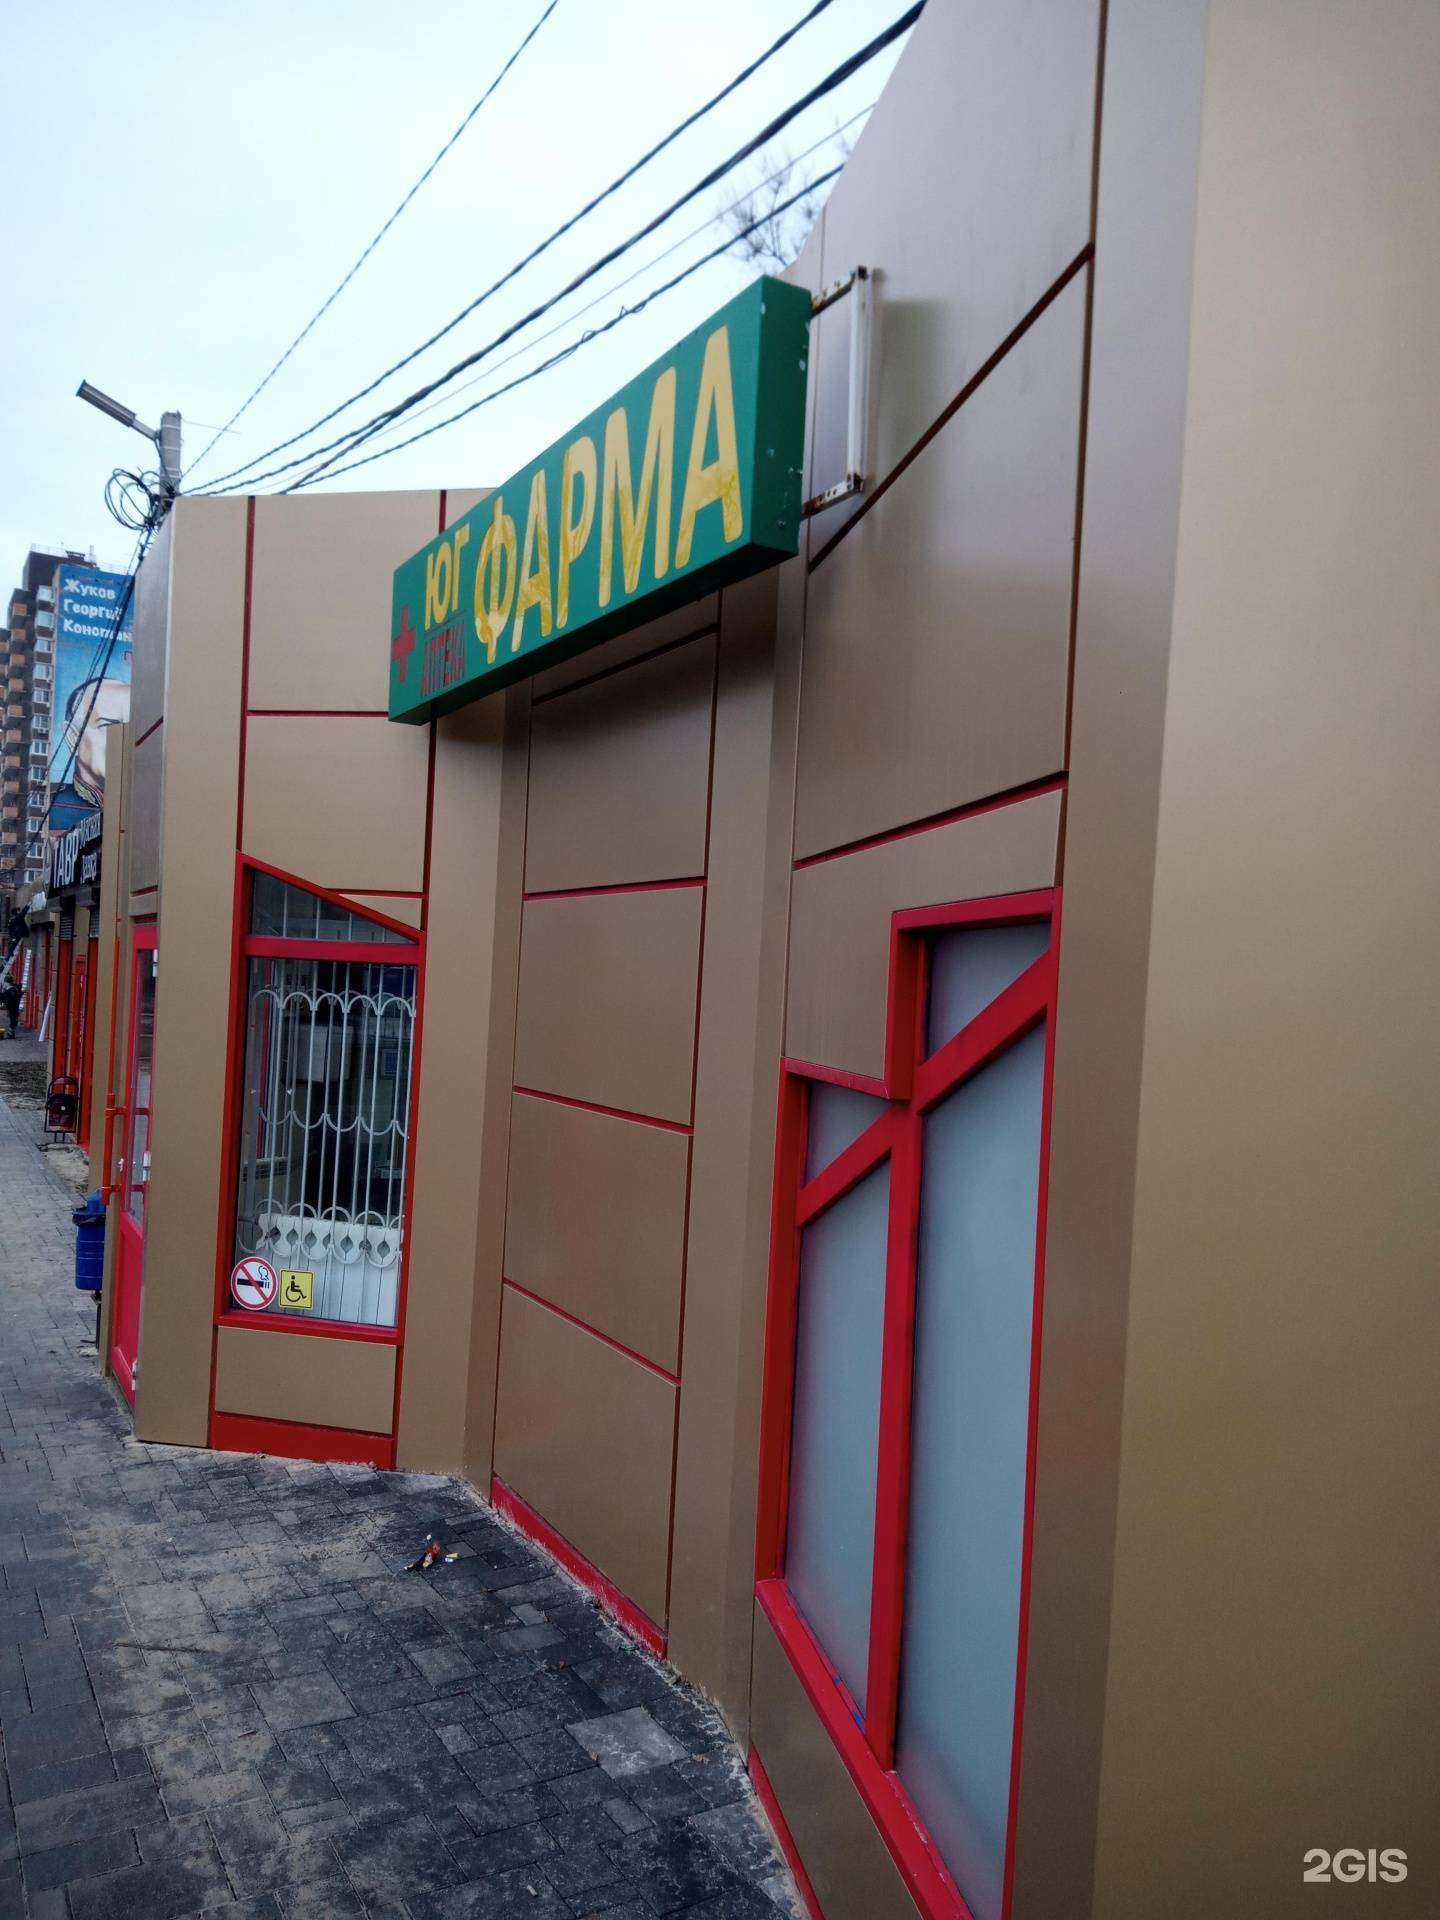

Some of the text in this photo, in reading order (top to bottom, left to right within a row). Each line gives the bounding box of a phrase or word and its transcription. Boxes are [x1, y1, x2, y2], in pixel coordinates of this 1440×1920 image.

[425, 325, 743, 664] ЮГ ФАРМА
[63, 578, 116, 600] Жуков
